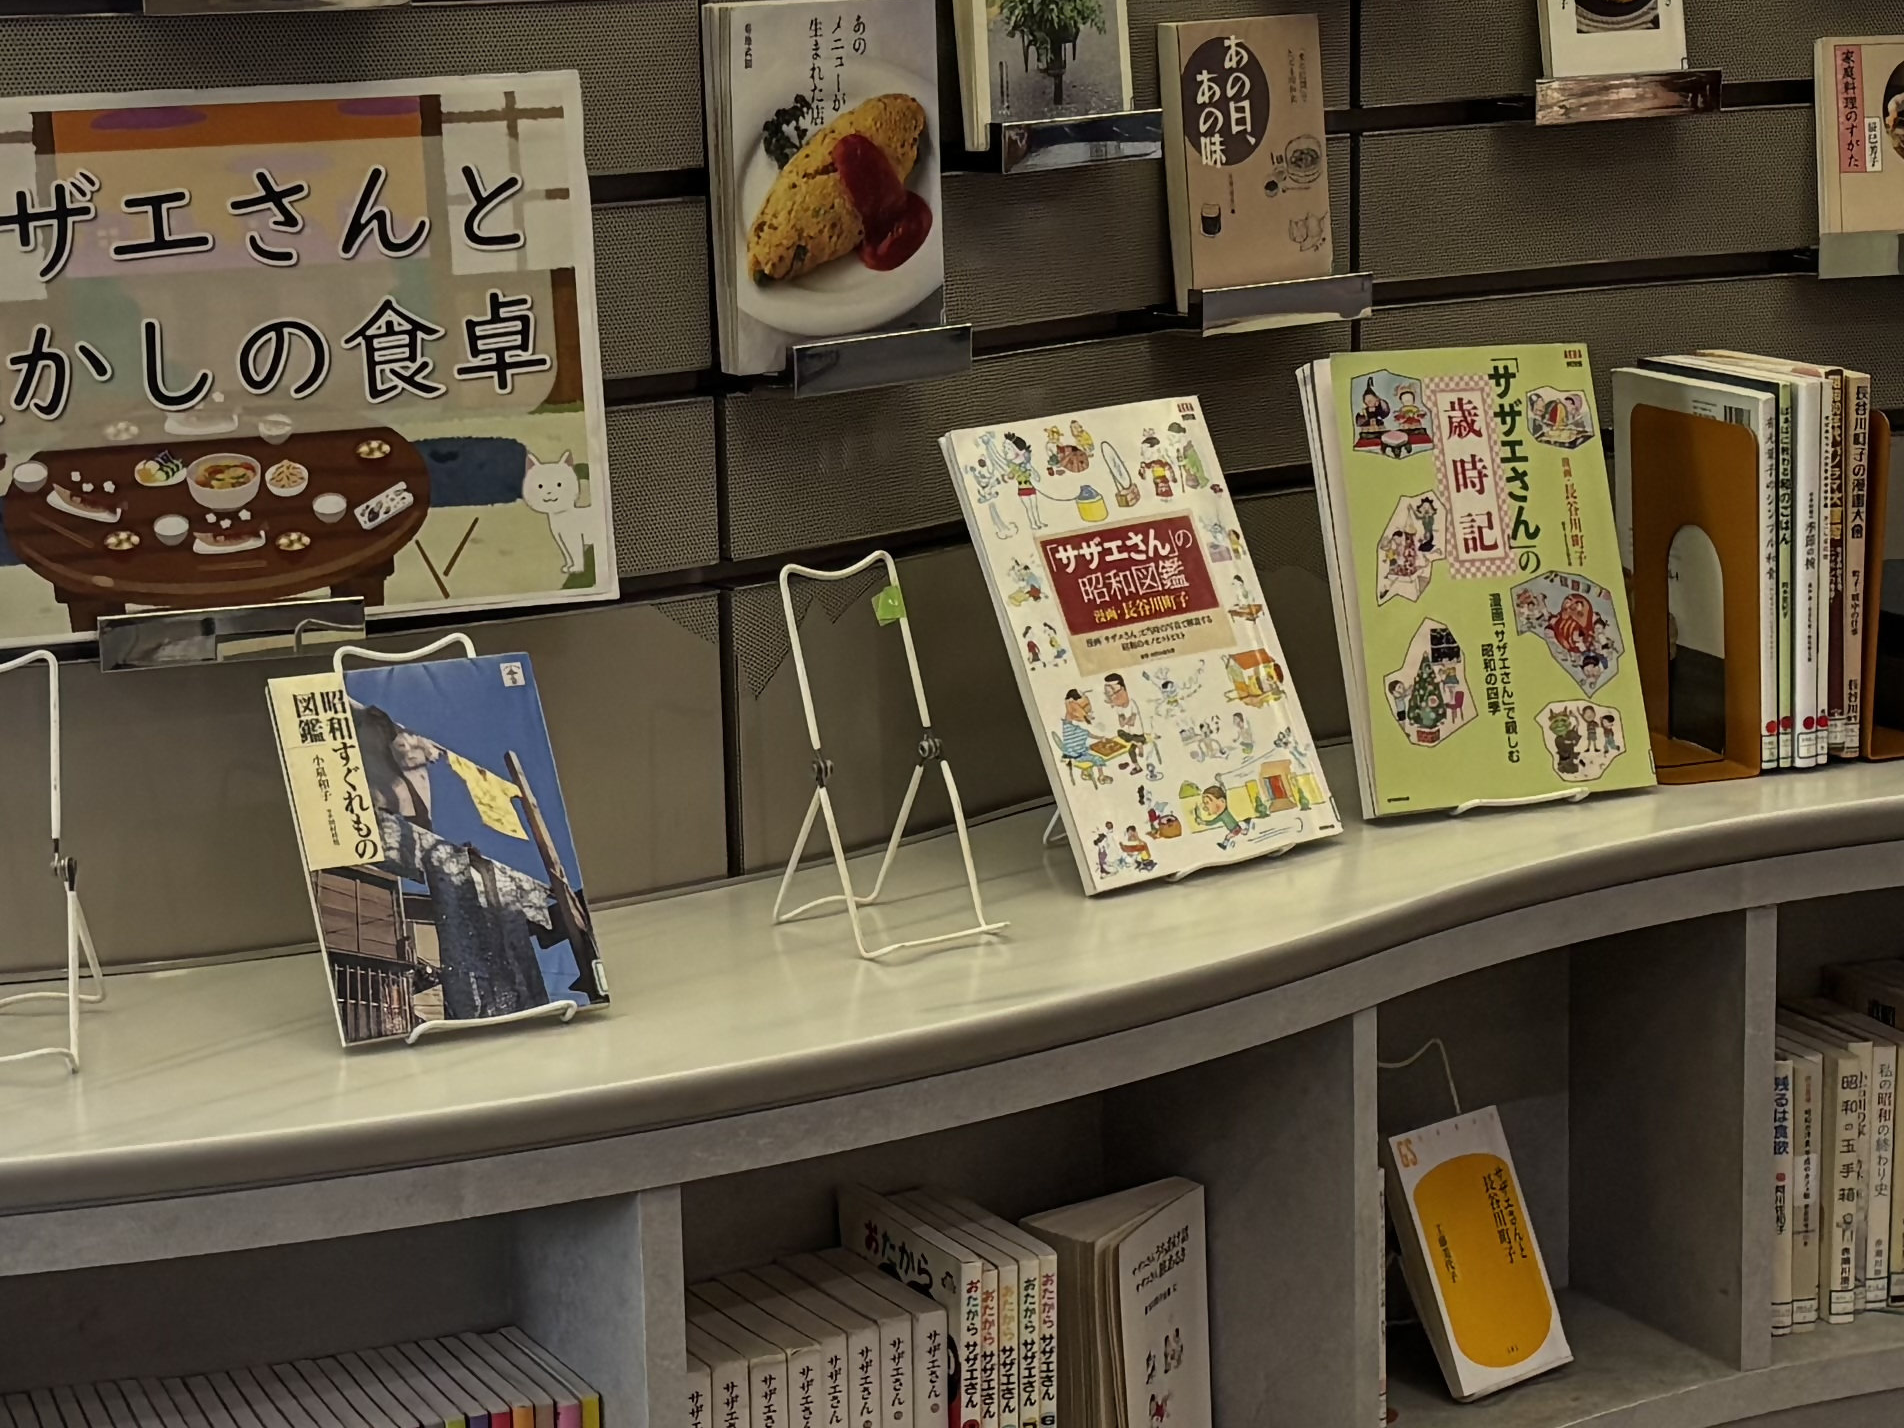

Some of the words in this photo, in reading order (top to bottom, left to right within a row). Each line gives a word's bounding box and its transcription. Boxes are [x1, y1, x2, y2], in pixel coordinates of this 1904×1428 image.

[831, 15, 846, 113] メニューが
[852, 14, 867, 55] あの
[809, 17, 824, 126] 生まれた店
[1196, 69, 1227, 169] あの味
[1443, 396, 1500, 555] 歳時記
[1046, 528, 1193, 573] 「サザエさん」の
[1078, 556, 1189, 604] 昭和図鑑
[292, 692, 326, 744] 図鑑
[320, 689, 378, 859] 昭和すぐれもの
[1838, 1074, 1859, 1203] 昭和の玉手箱
[1483, 1173, 1517, 1264] 長谷川町子
[827, 1355, 843, 1425] サザエさん
[859, 1346, 874, 1417] サザエさん
[889, 1337, 905, 1407] サザエさん
[926, 1330, 941, 1399] サザエさん
[964, 1341, 978, 1408] サザエさん
[981, 1351, 996, 1419] サザエさん
[1001, 1346, 1016, 1414] サザエさん
[1022, 1339, 1037, 1407] サザエさん
[1040, 1334, 1055, 1401] サザエさん
